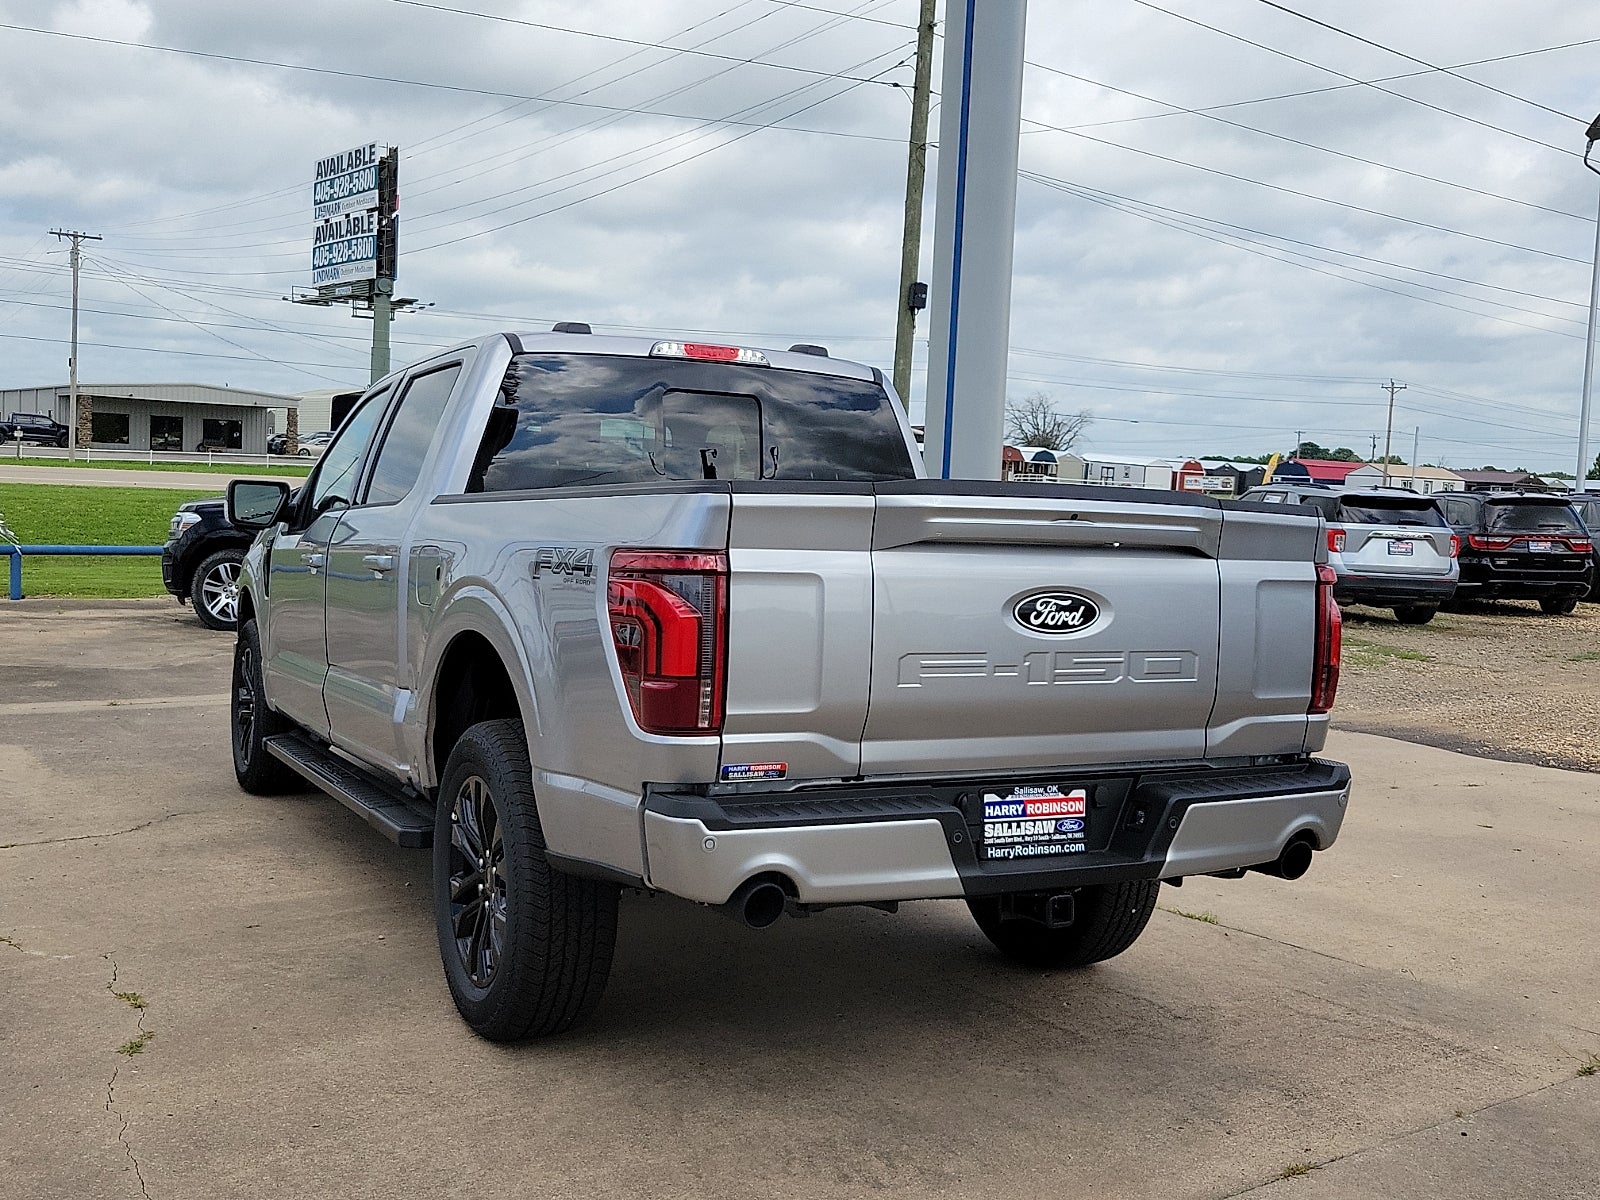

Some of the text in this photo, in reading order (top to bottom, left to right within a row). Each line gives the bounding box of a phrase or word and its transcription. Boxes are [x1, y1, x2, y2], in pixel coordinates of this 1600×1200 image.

[316, 144, 376, 180] AVAILABLE
[315, 167, 375, 203] 405-928-5800
[314, 214, 373, 245] AVAILABLE
[313, 237, 373, 267] 405-928-5800
[533, 547, 594, 579] FX4
[896, 650, 1200, 688] F-150
[1014, 785, 1059, 796] Sallisaw, OK
[985, 801, 1084, 817] HARRY ROBINSON
[984, 820, 1056, 838] SALLISAW
[987, 843, 1085, 859] HarryRobinson.com
